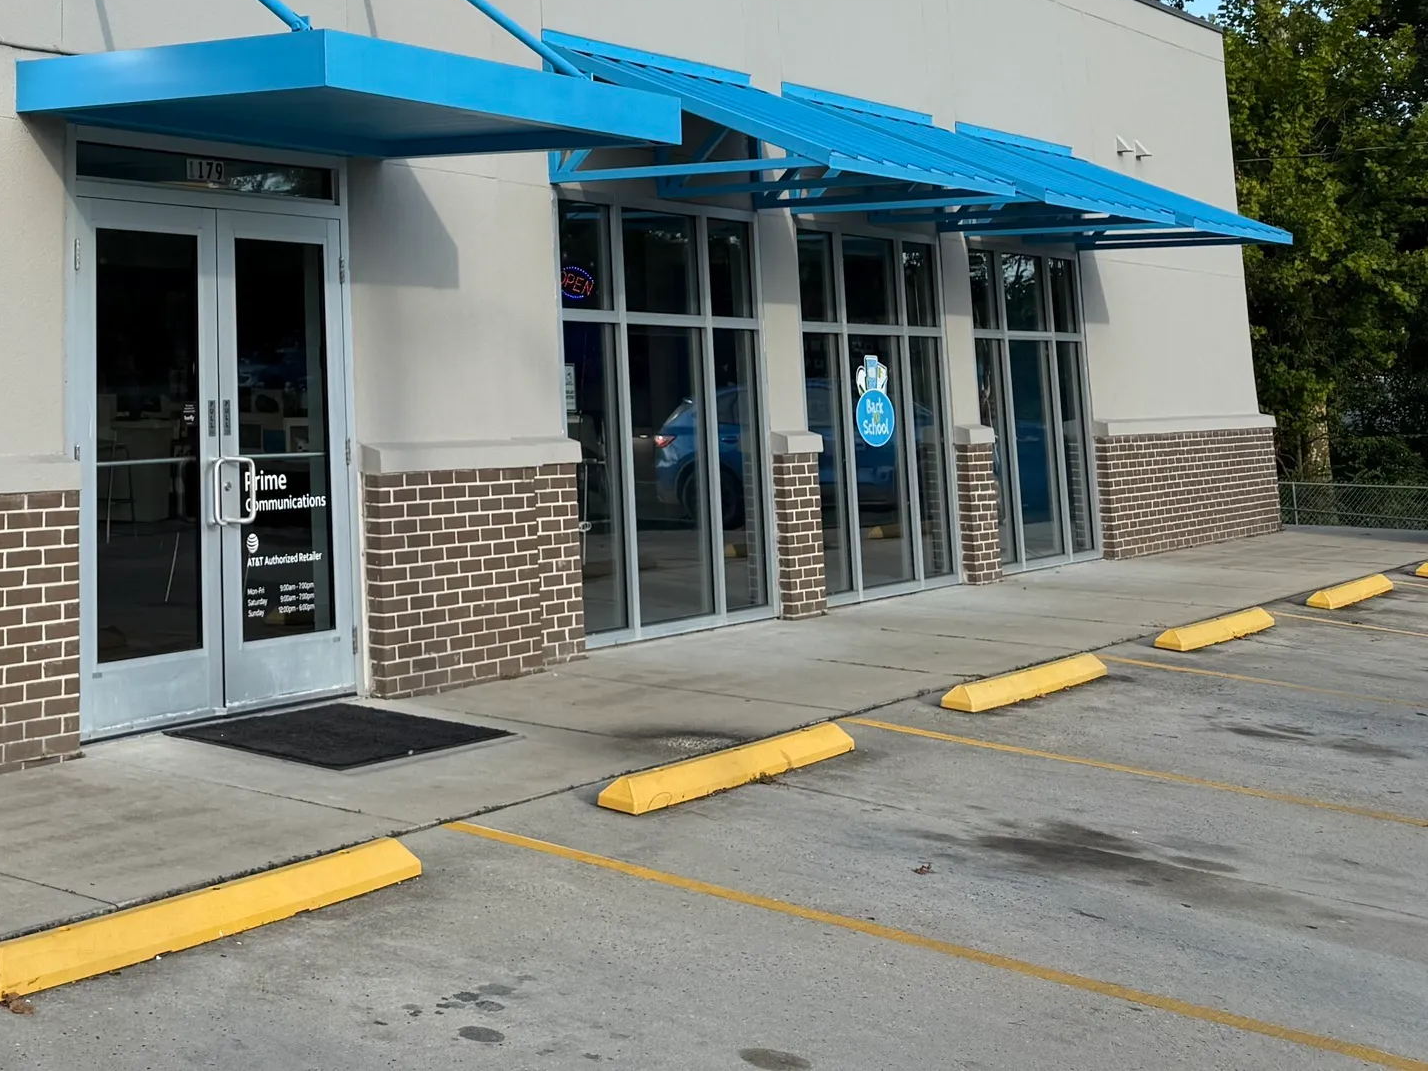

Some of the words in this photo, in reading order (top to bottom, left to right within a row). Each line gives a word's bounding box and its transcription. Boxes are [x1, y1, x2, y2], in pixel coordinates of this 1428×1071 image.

[561, 271, 593, 296] OPEN
[866, 397, 884, 414] Back
[863, 418, 889, 435] School
[245, 470, 287, 491] Prime
[247, 556, 264, 567] AT&T
[264, 554, 298, 566] Authorized
[299, 550, 322, 562] Retailer
[248, 609, 265, 618] Sunday
